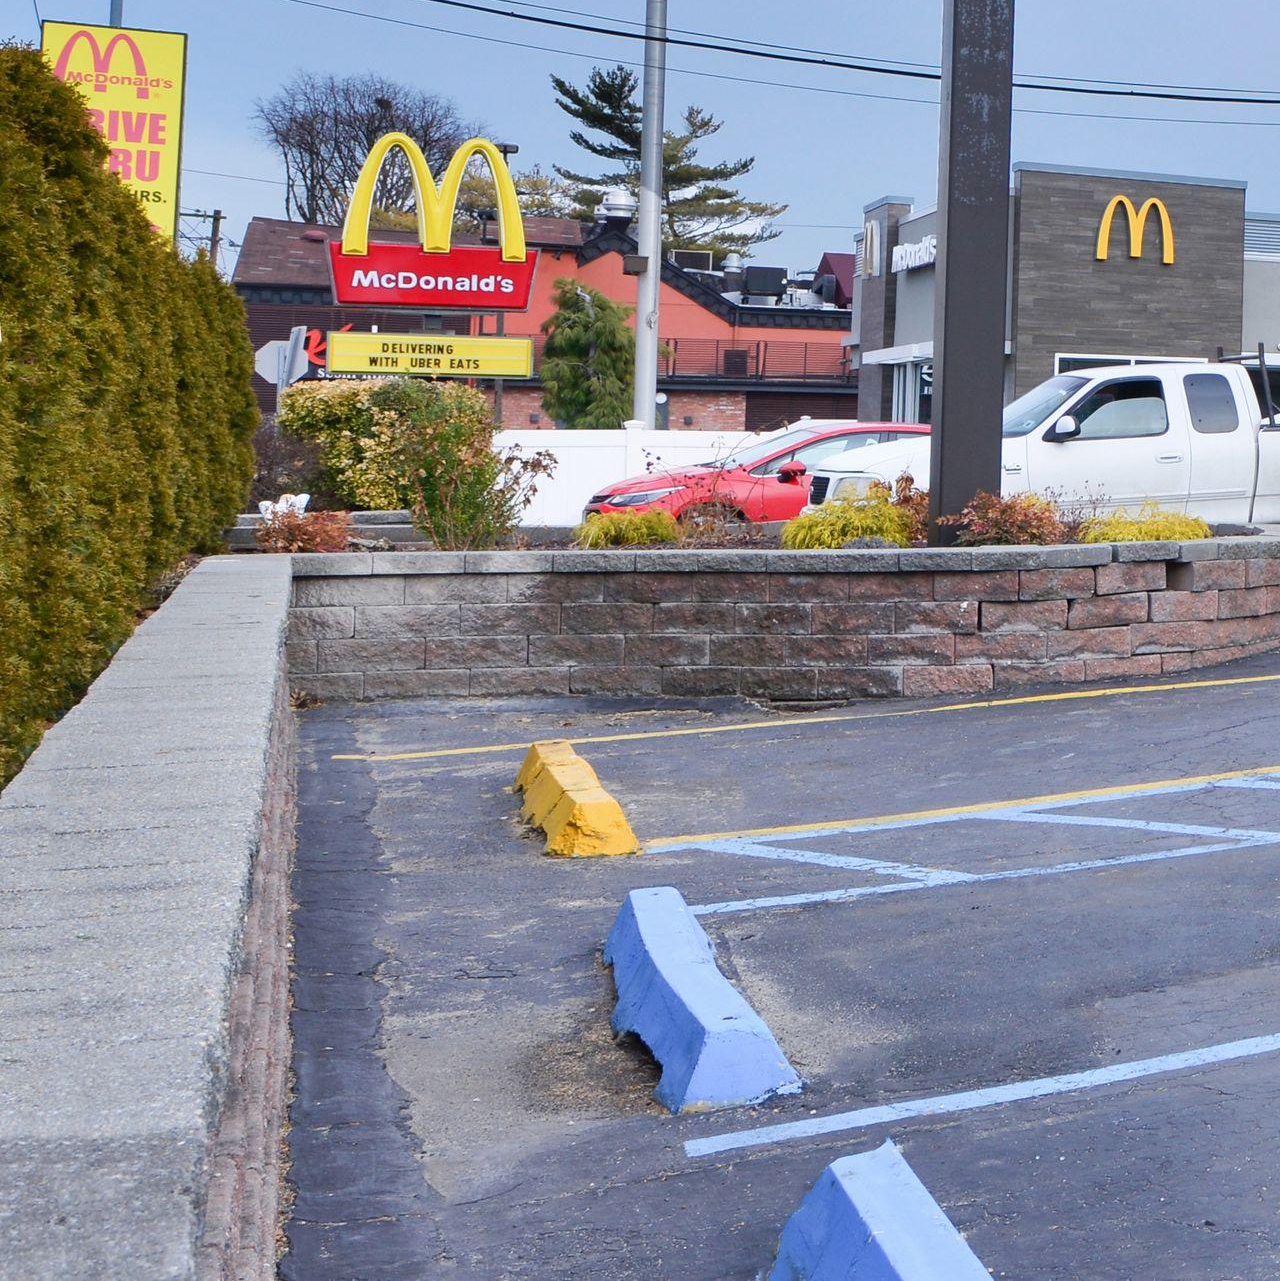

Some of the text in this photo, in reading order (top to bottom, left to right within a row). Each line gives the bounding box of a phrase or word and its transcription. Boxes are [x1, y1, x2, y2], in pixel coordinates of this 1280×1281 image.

[66, 71, 174, 89] McDonald's
[87, 109, 167, 145] RIVE
[351, 270, 514, 293] McDonald's
[381, 342, 454, 355] DELIVERING
[368, 356, 480, 369] WITH UBER EATS
